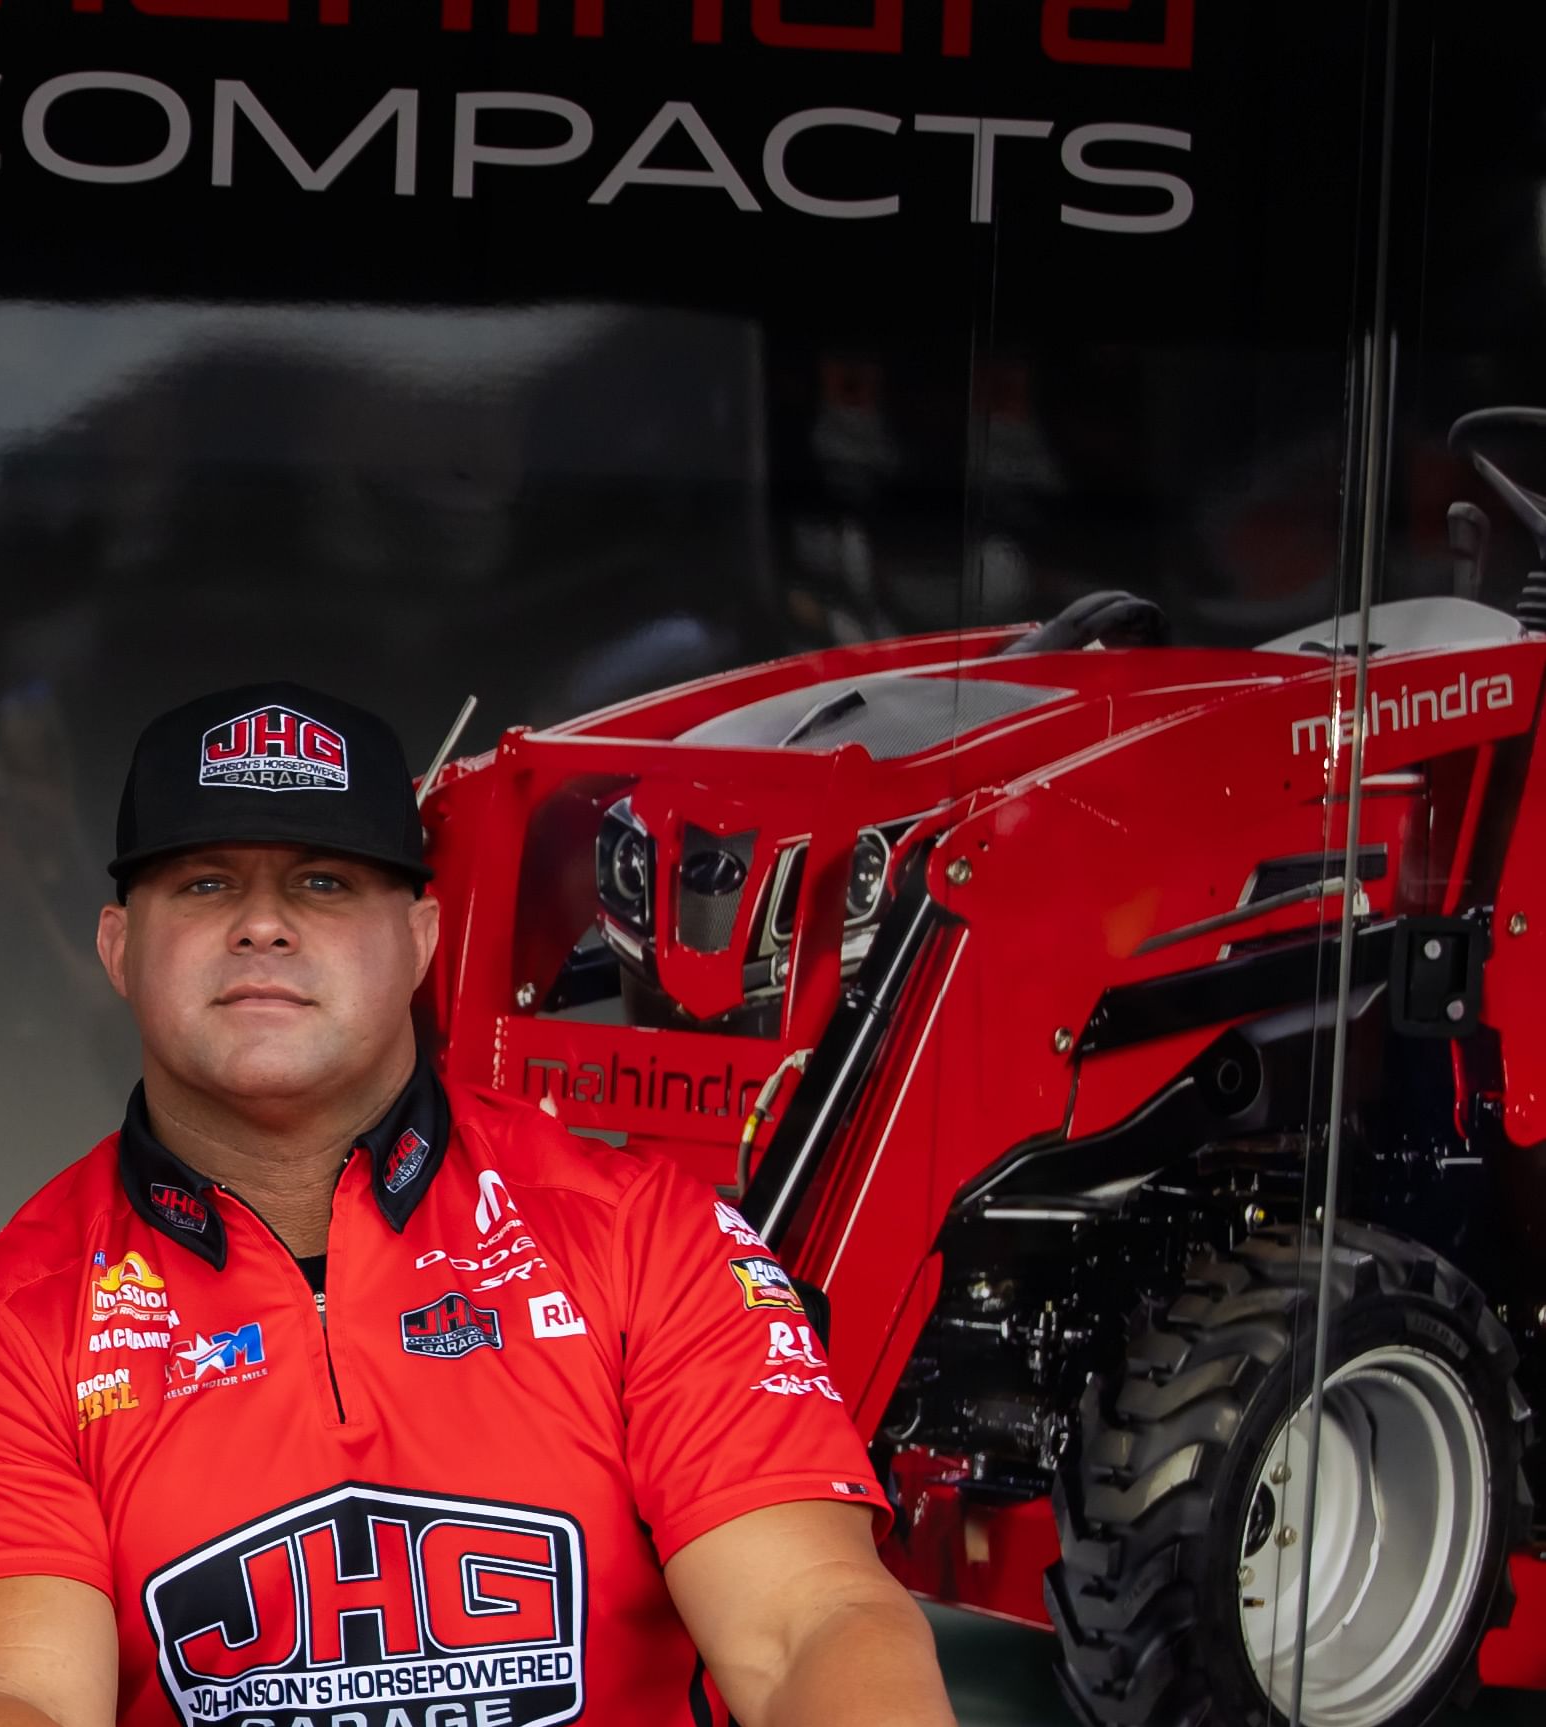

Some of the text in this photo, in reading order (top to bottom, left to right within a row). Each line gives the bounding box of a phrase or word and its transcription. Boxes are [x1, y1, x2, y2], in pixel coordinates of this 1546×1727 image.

[206, 713, 343, 769] JHG
[1292, 671, 1513, 756] mahindra
[202, 759, 345, 781] JOHNSON'S HORSEPOWERED
[224, 770, 327, 786] GARAGE
[522, 1052, 763, 1118] mahindr
[415, 1236, 536, 1270] DODG
[175, 1515, 561, 1683] JHG
[188, 1651, 573, 1717] JOHNSON'S HORSEPOWERED
